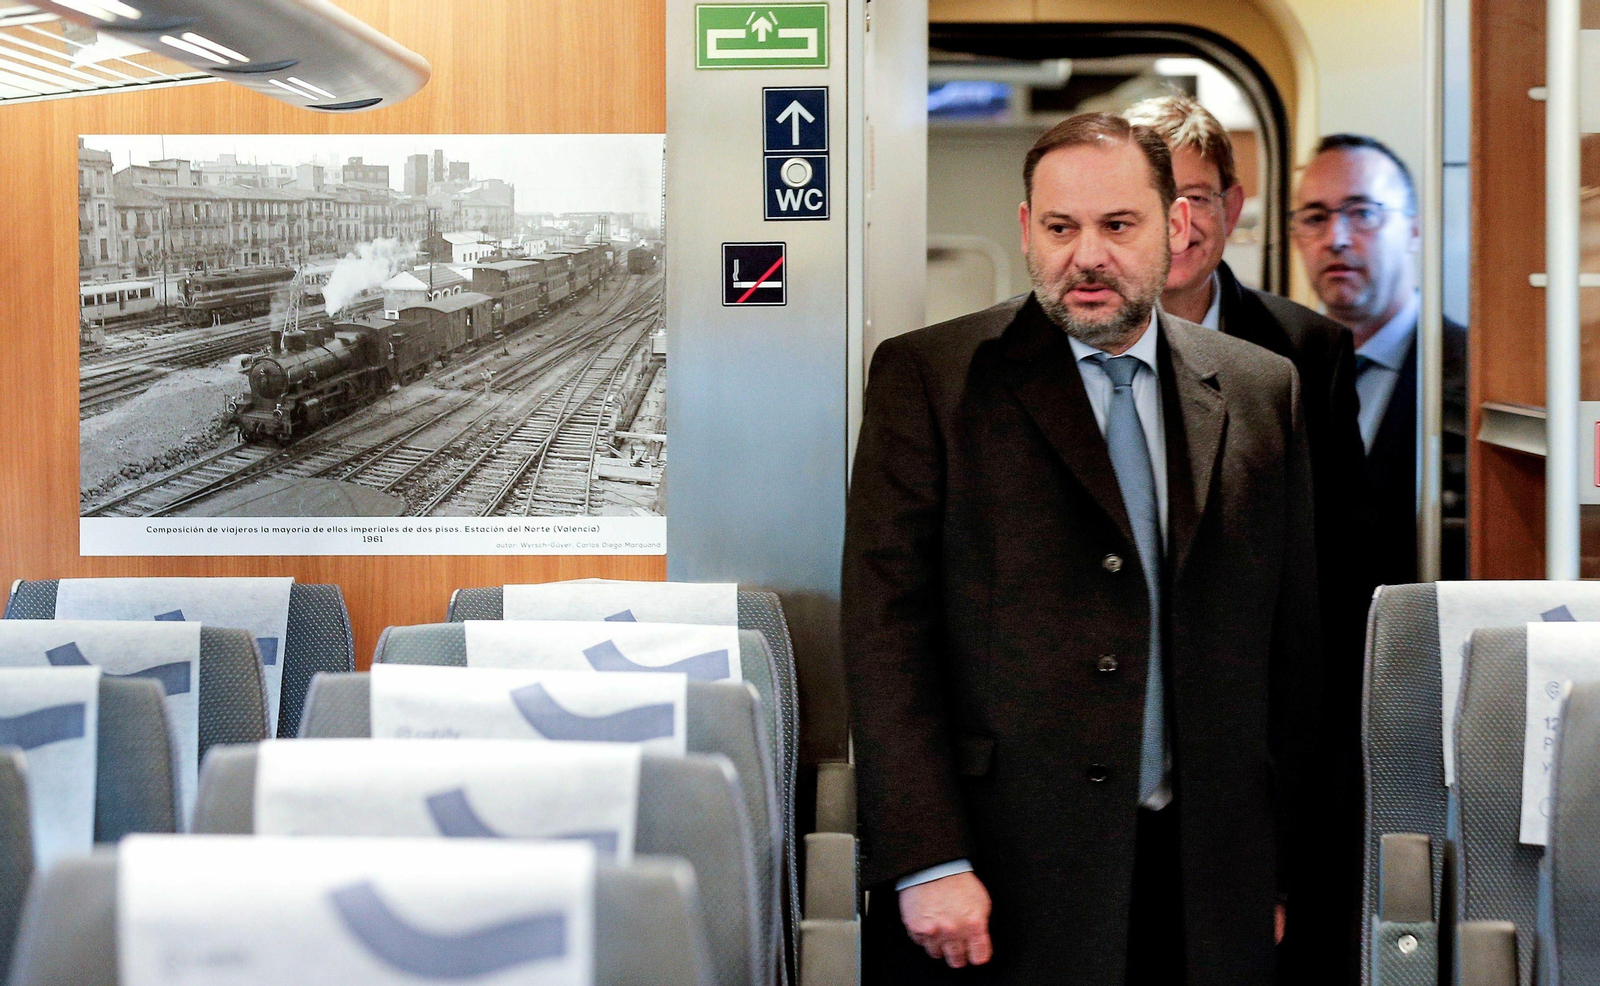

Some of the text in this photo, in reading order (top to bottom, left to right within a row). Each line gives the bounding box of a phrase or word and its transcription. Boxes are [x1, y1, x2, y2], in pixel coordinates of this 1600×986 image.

[775, 188, 823, 211] WC
[146, 525, 204, 535] Composición
[221, 525, 259, 536] viajeros
[260, 525, 270, 533] la
[312, 525, 325, 533] de
[326, 525, 348, 533] ellos
[350, 525, 400, 535] imperiales
[402, 525, 414, 533] de
[416, 525, 433, 533] dos
[435, 526, 462, 535] pisos.
[464, 525, 505, 533] Estación
[507, 525, 522, 533] del
[553, 525, 601, 534] (Valencia)
[362, 535, 384, 543] 1961
[576, 541, 600, 549] Carlos
[601, 541, 623, 550] Diego
